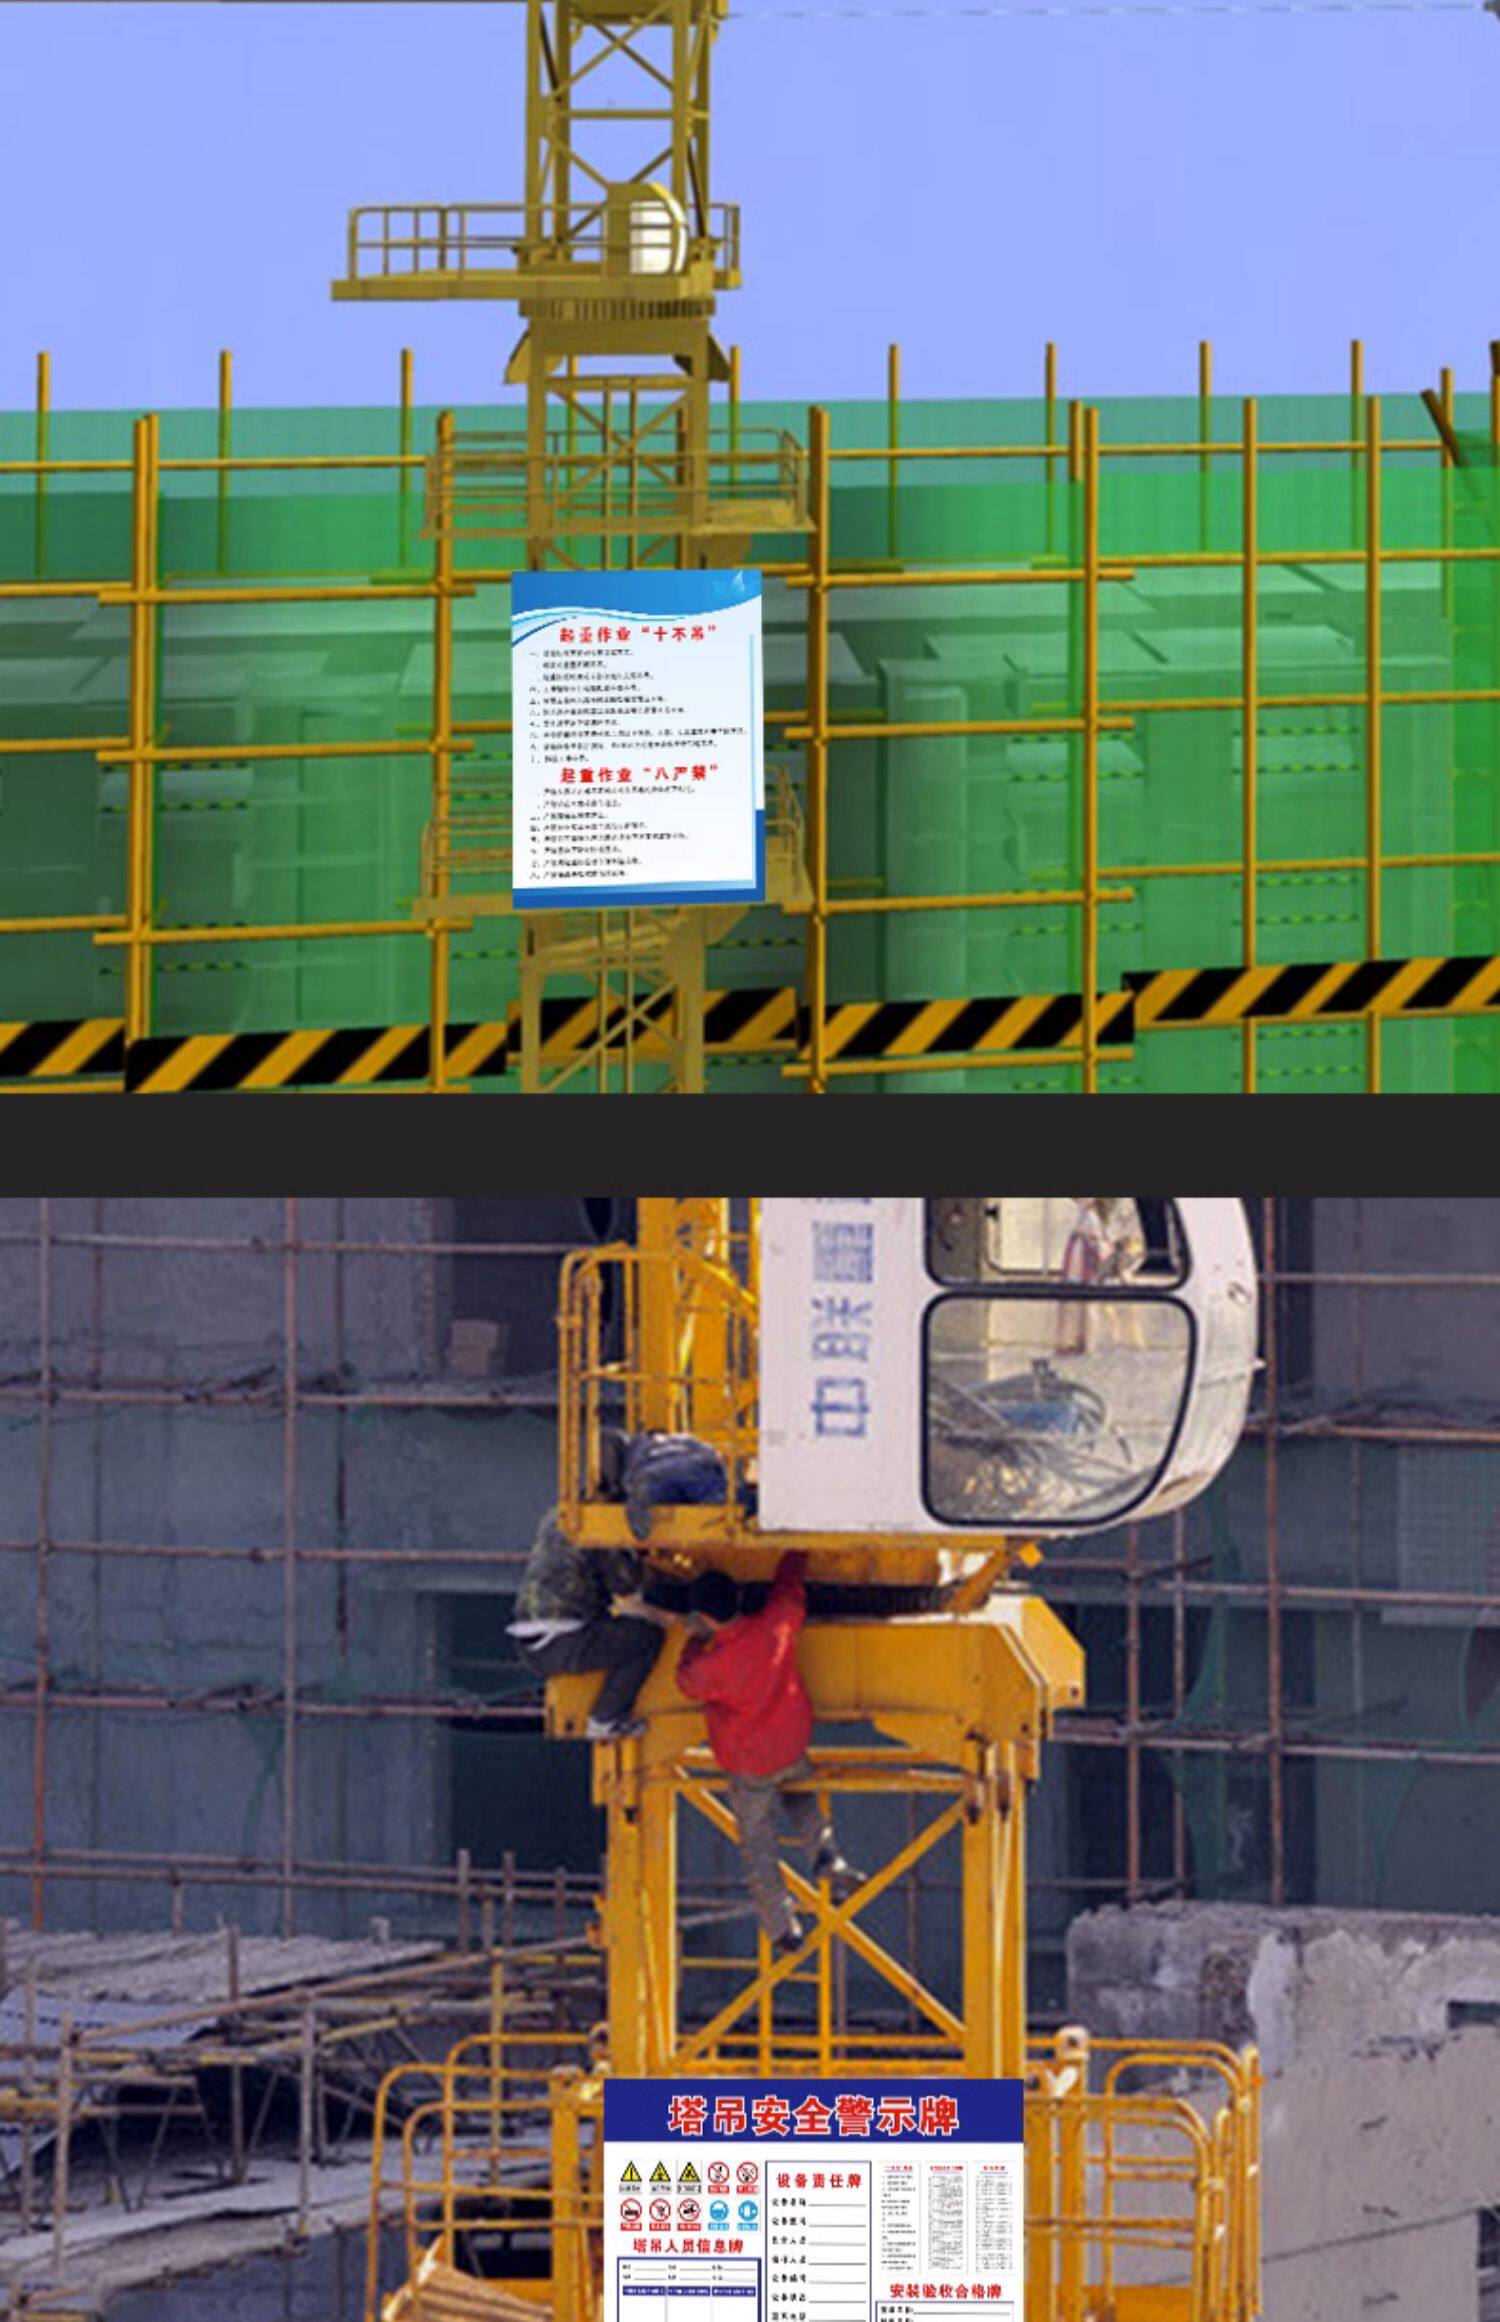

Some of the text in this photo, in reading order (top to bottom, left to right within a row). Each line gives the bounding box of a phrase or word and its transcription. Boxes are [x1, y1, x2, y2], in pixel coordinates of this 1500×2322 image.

[809, 1198, 873, 1438] 中联重
[668, 2095, 960, 2136] 塔吊安全警示牌
[777, 2173, 862, 2188] 设备责任牌
[632, 2238, 744, 2254] 塔吊人员信息牌
[890, 2284, 1002, 2299] 安装验收合格牌
